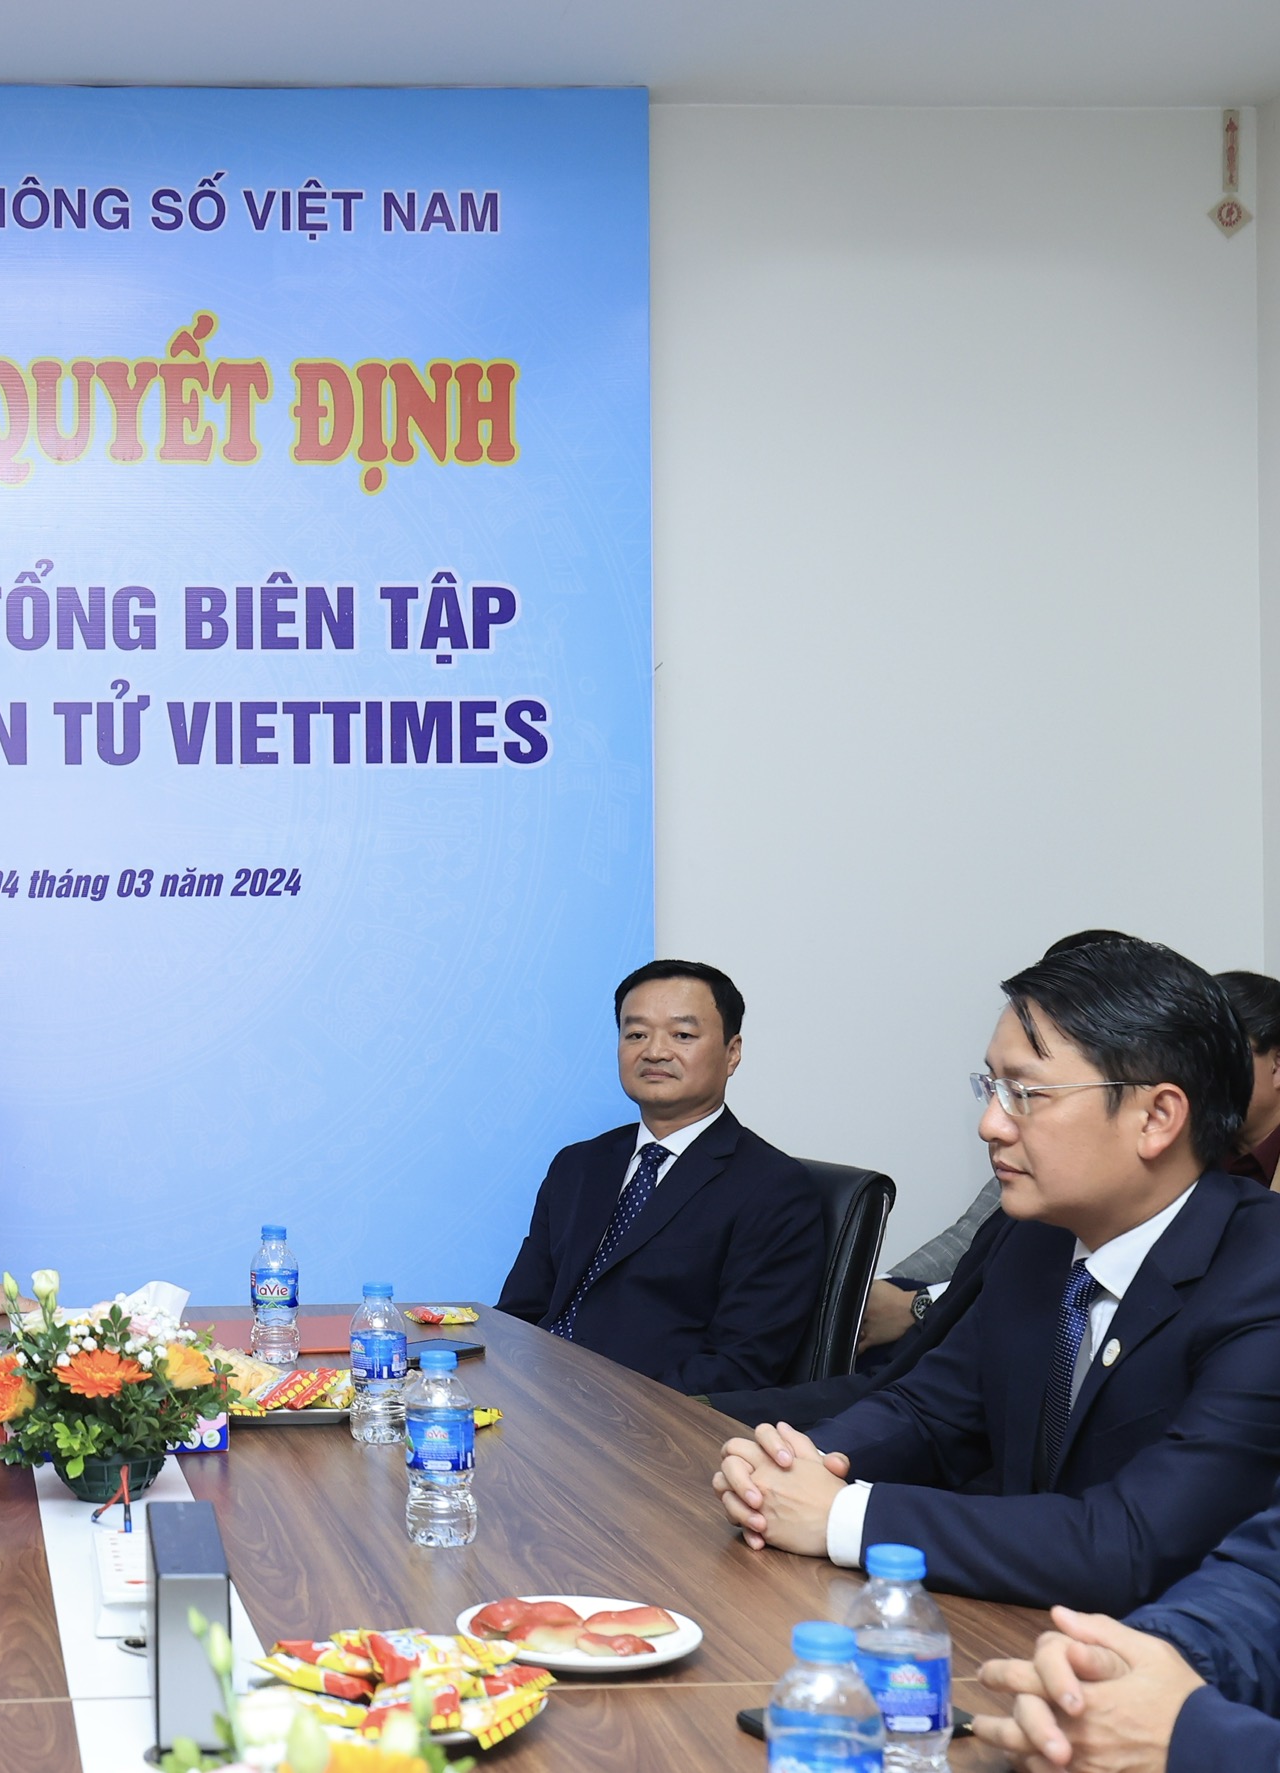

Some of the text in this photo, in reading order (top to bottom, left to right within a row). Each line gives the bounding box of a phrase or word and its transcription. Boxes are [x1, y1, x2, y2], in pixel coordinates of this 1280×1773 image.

[151, 171, 227, 232] SỐ
[244, 178, 364, 241] VIỆT
[383, 191, 499, 233] NAM
[291, 358, 519, 494] ĐỊNH
[184, 571, 355, 650] BIÊN
[379, 571, 517, 664] TẬP
[53, 678, 151, 766] TỬ
[166, 699, 549, 765] VIETTIMES
[28, 868, 110, 902] tháng
[117, 868, 154, 898] 03
[160, 867, 224, 897] năm
[231, 867, 302, 897] 2024
